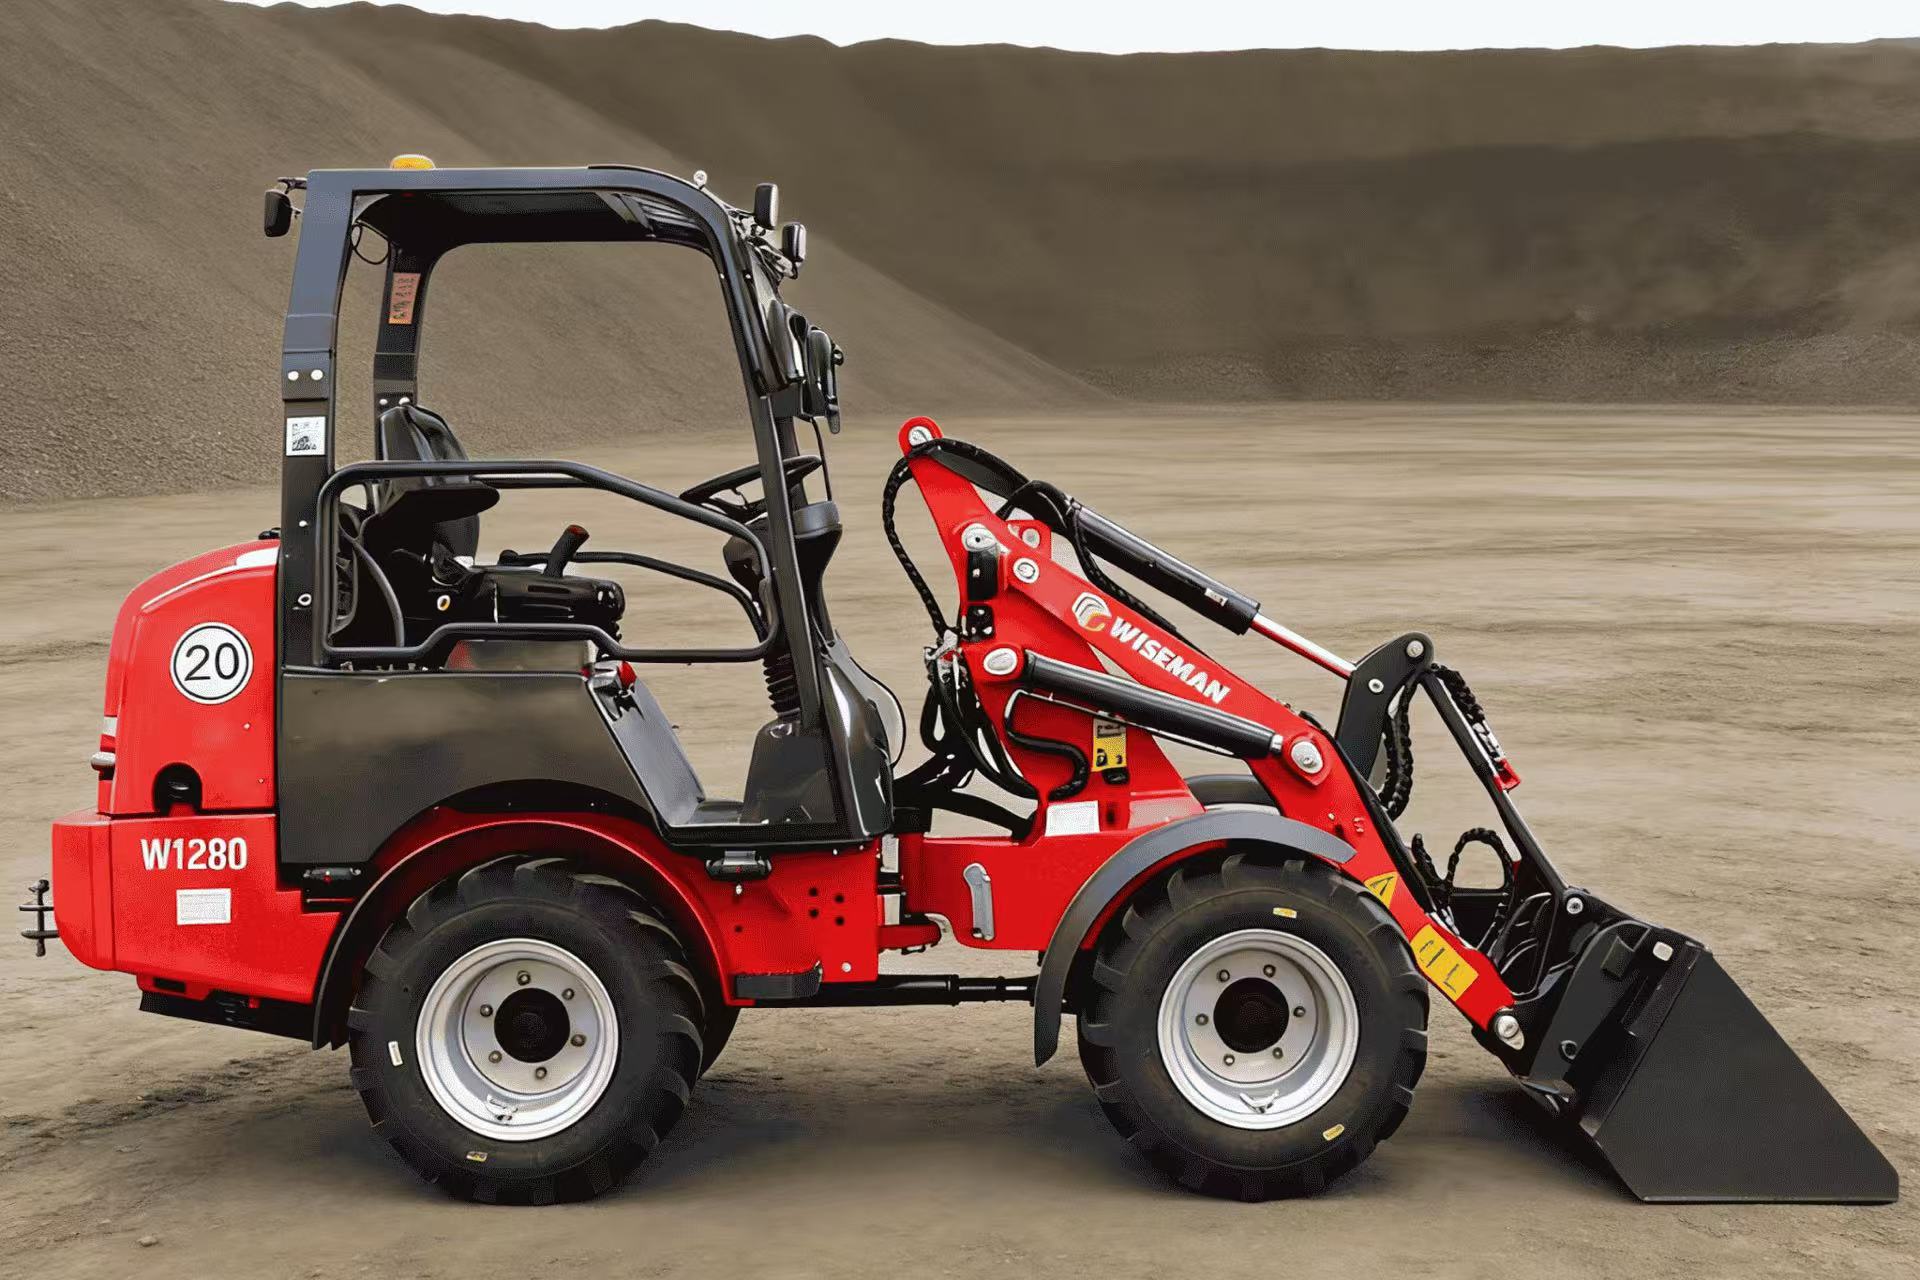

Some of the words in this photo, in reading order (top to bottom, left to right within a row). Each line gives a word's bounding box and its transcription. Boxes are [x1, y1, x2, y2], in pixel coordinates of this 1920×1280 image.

[184, 642, 240, 682] 20
[1110, 616, 1231, 704] WISEMAN
[140, 837, 248, 871] W1280
